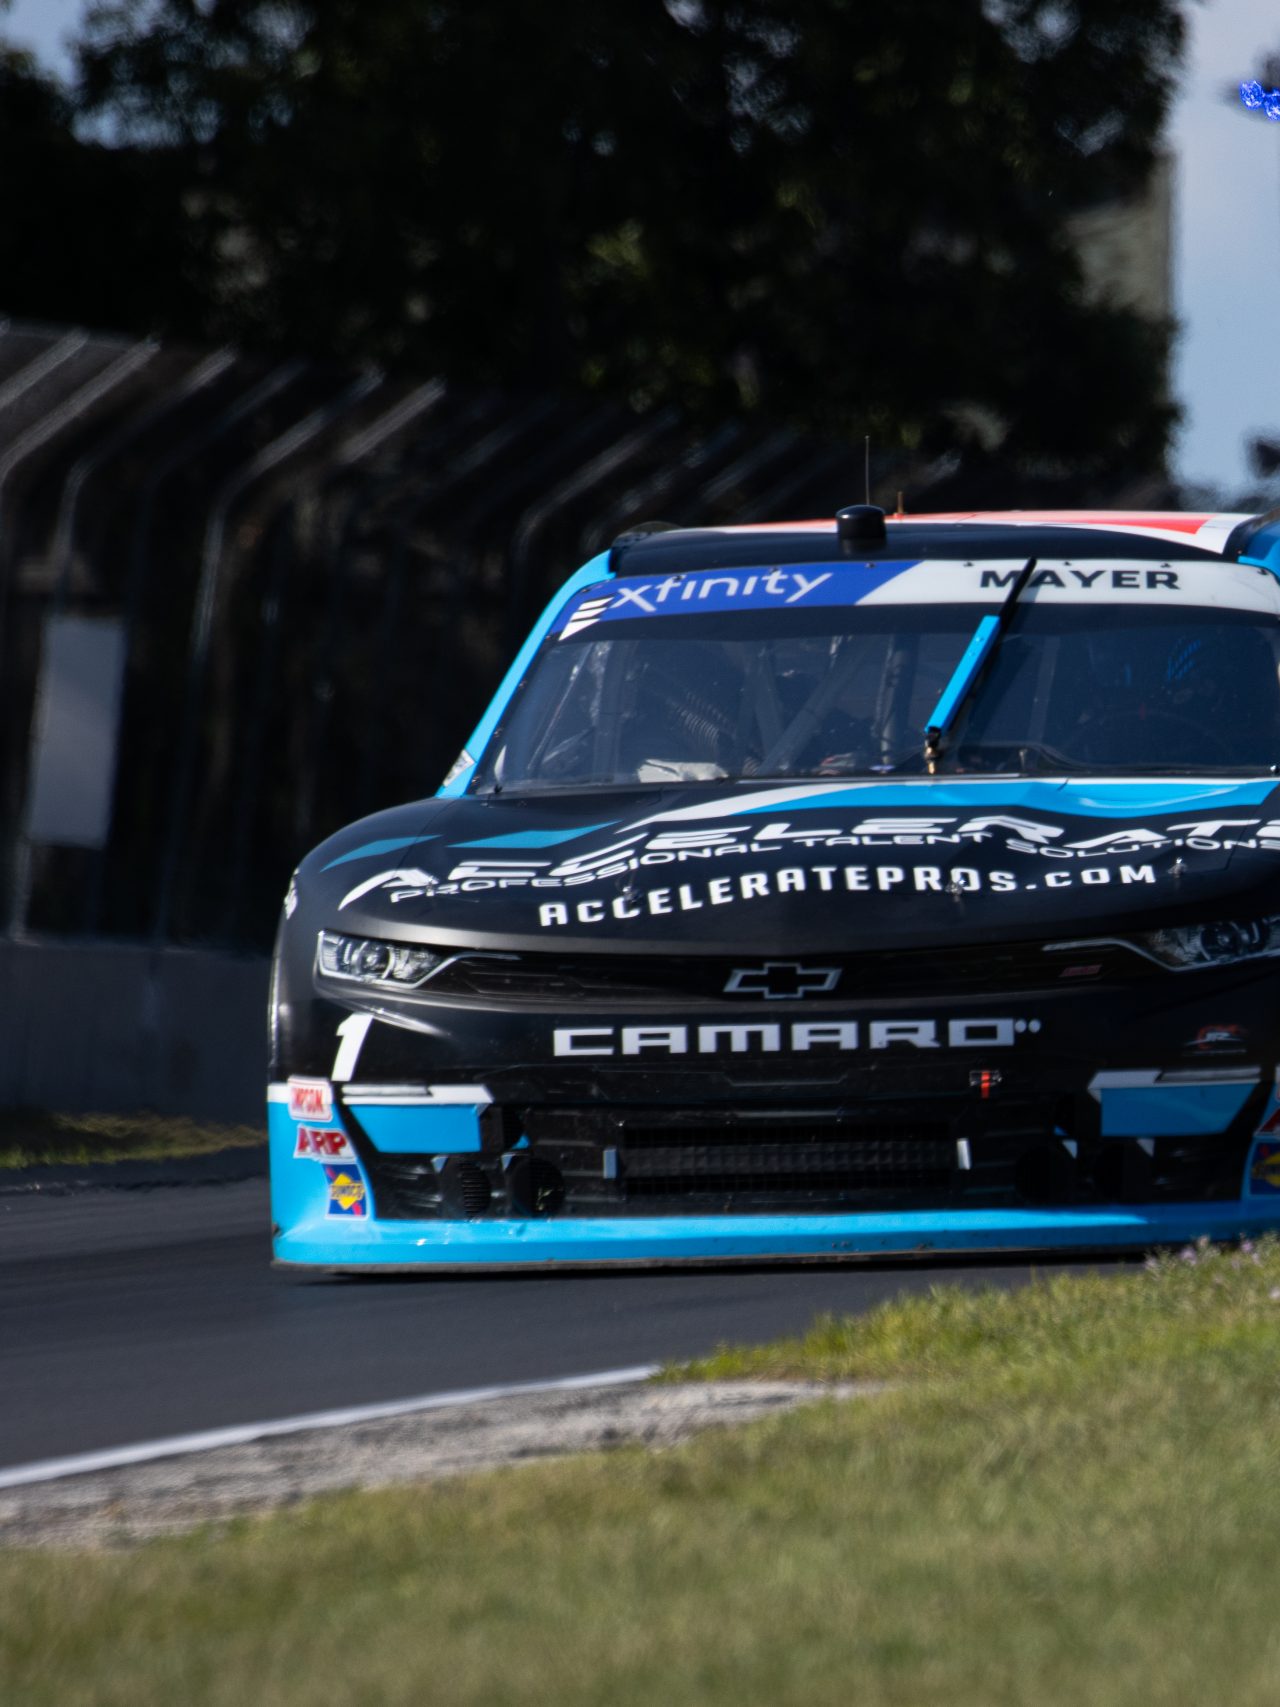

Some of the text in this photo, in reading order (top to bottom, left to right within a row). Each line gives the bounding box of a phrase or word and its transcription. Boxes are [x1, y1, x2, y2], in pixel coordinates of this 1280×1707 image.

[609, 571, 833, 613] xfinity
[980, 569, 1181, 590] MAYER
[390, 843, 783, 903] PROFESSIONAL
[792, 831, 994, 848] TALENT
[539, 864, 1157, 927] ACCELERATEPROS.COM
[332, 1012, 374, 1082] 1
[553, 1018, 1014, 1058] CAMARO
[297, 1127, 348, 1156] ARP
